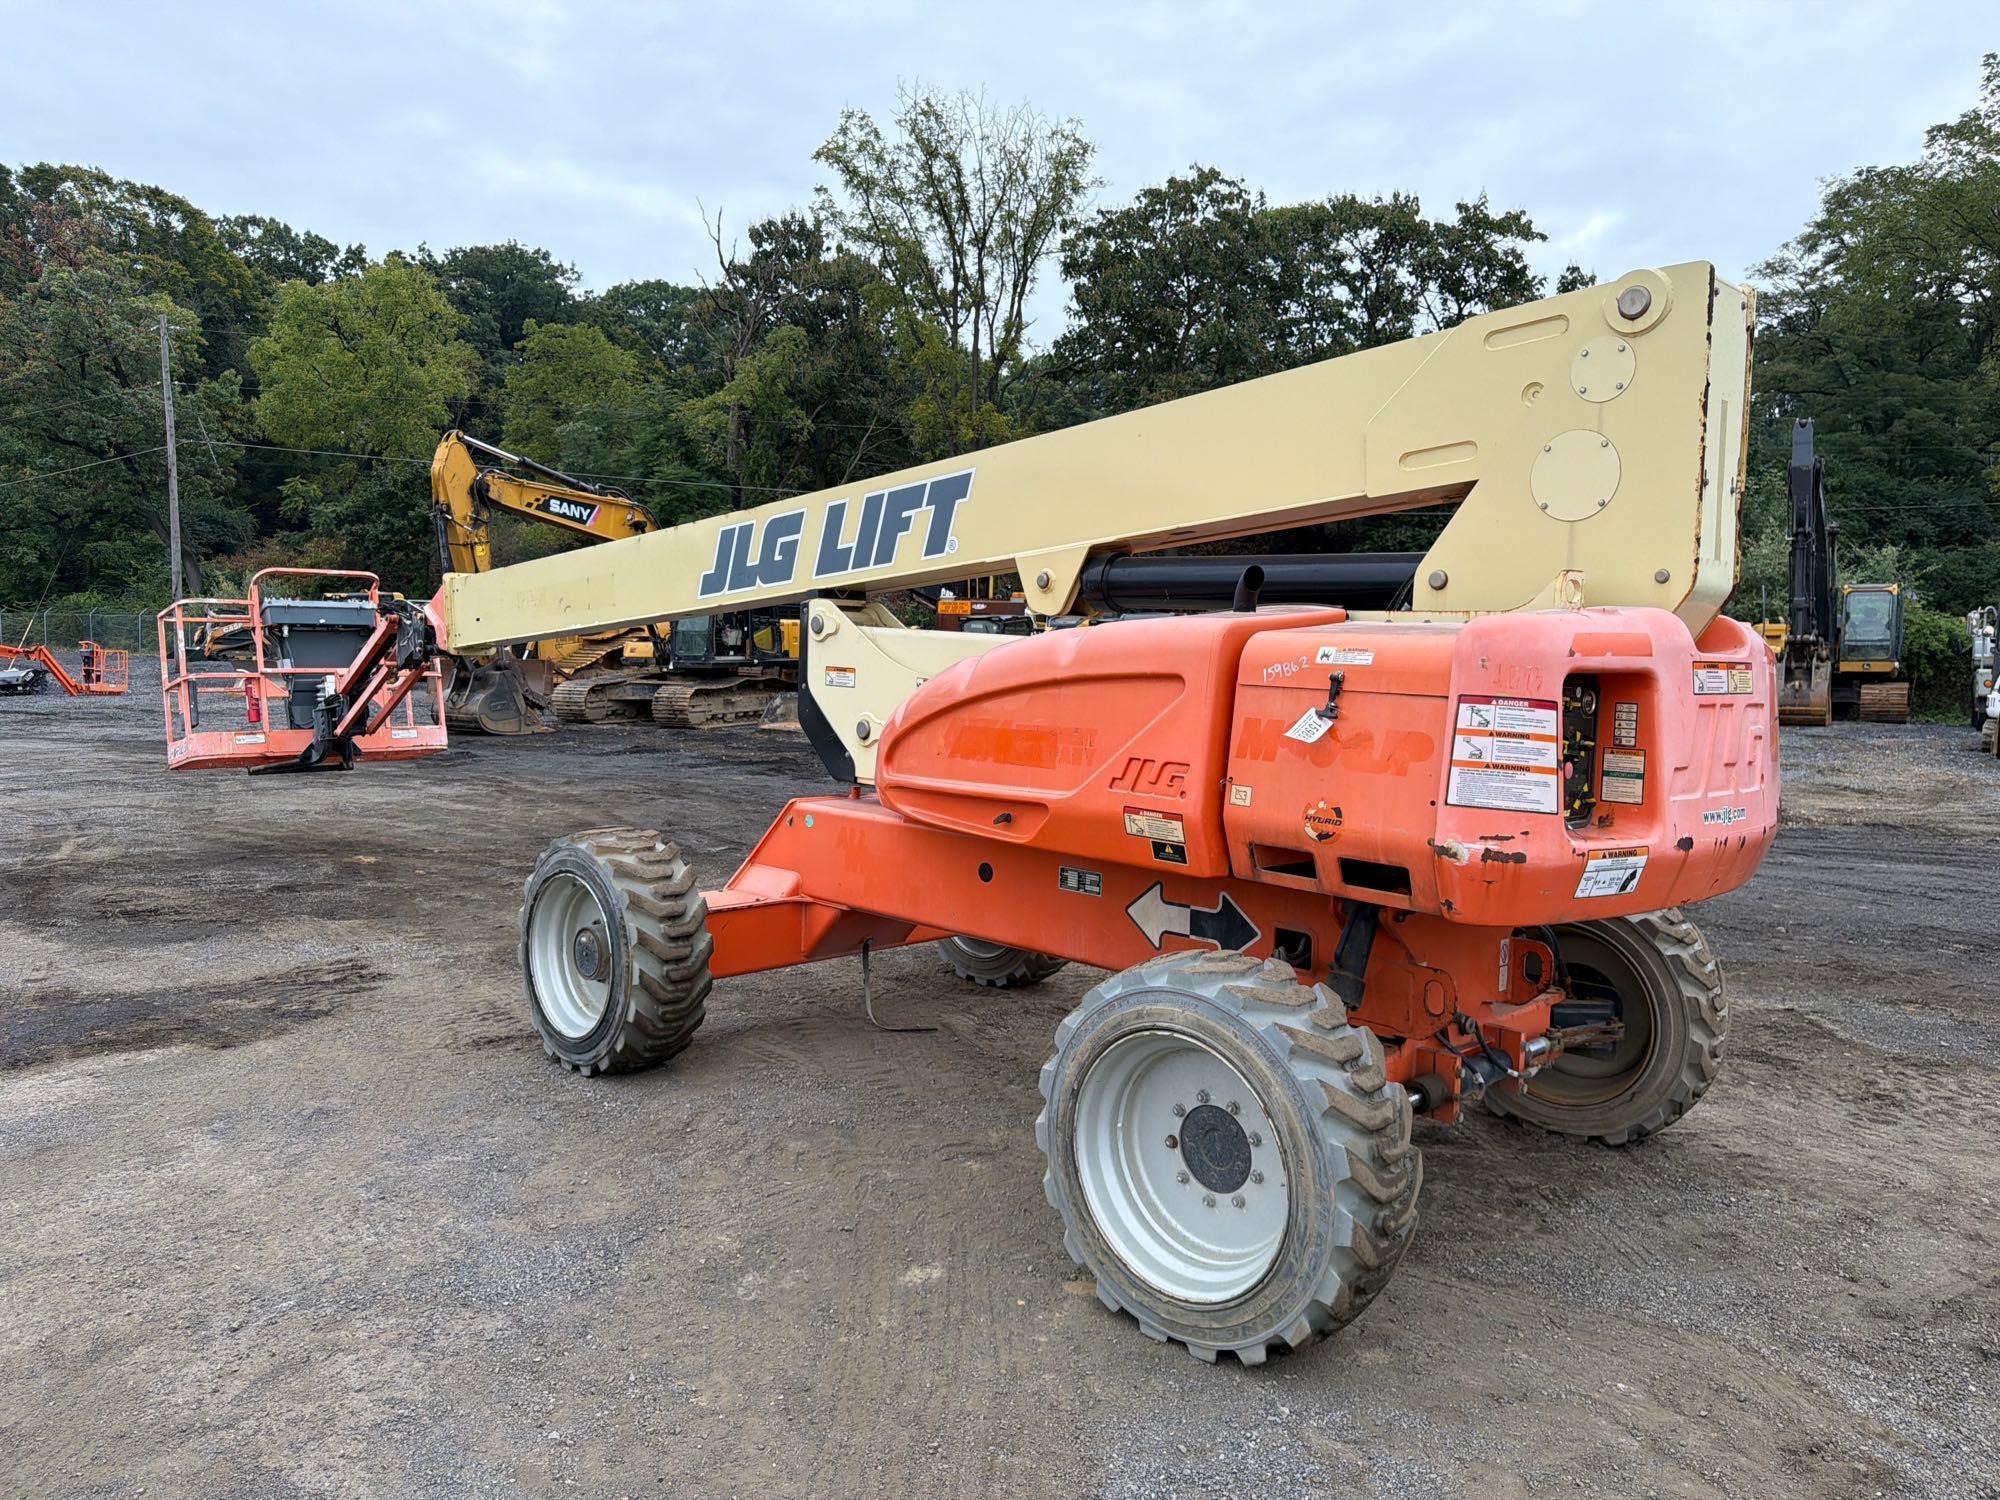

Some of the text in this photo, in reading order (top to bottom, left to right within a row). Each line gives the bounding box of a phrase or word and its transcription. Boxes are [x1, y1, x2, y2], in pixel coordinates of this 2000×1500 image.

[550, 499, 591, 520] SANY
[698, 468, 976, 598] JLG LIFT
[1498, 699, 1529, 708] DANGER
[1496, 730, 1531, 740] WARNING
[1492, 763, 1531, 773] WARNING
[1108, 757, 1190, 800] JLG
[1305, 814, 1343, 827] HYBRID
[1703, 807, 1745, 823] www.jlg.com
[1608, 849, 1638, 859] WARNING
